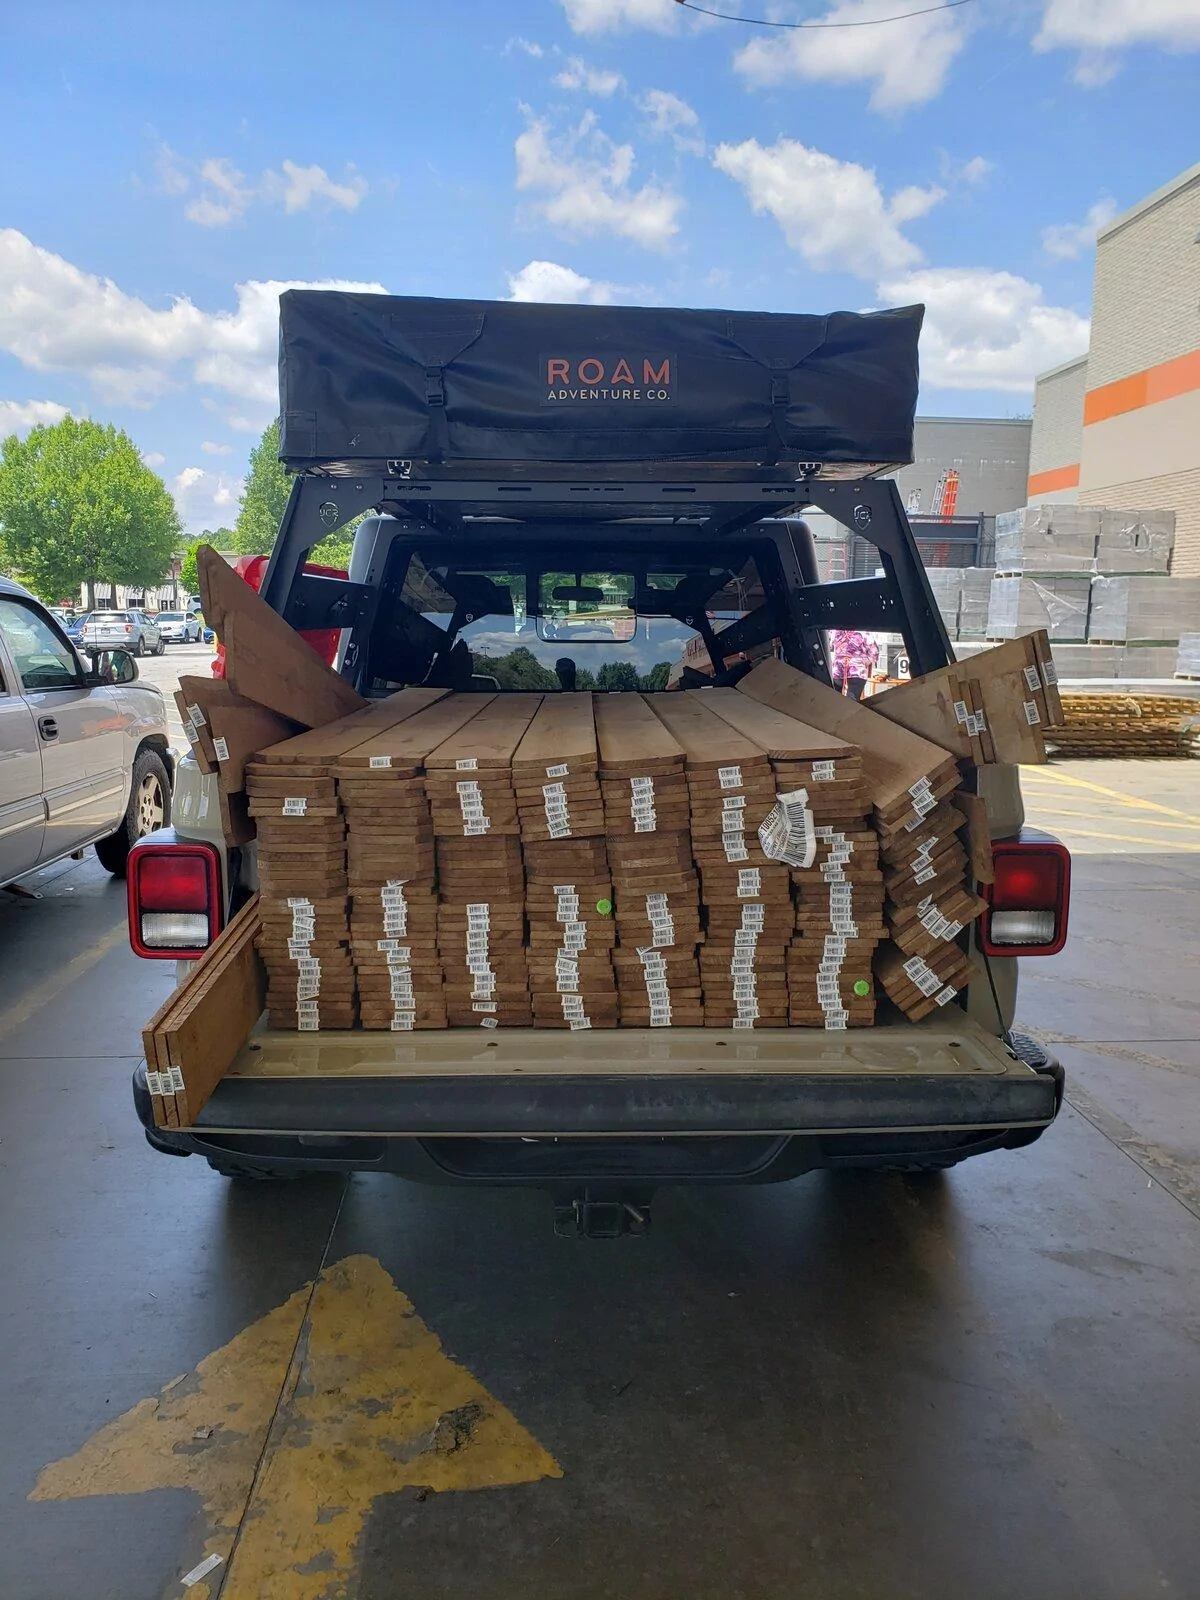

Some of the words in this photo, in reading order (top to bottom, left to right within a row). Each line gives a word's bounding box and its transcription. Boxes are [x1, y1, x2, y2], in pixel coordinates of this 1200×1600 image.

[547, 358, 670, 385] ROAM
[547, 389, 641, 400] ADVENTURE
[646, 389, 671, 400] CO.
[900, 659, 909, 674] 9
